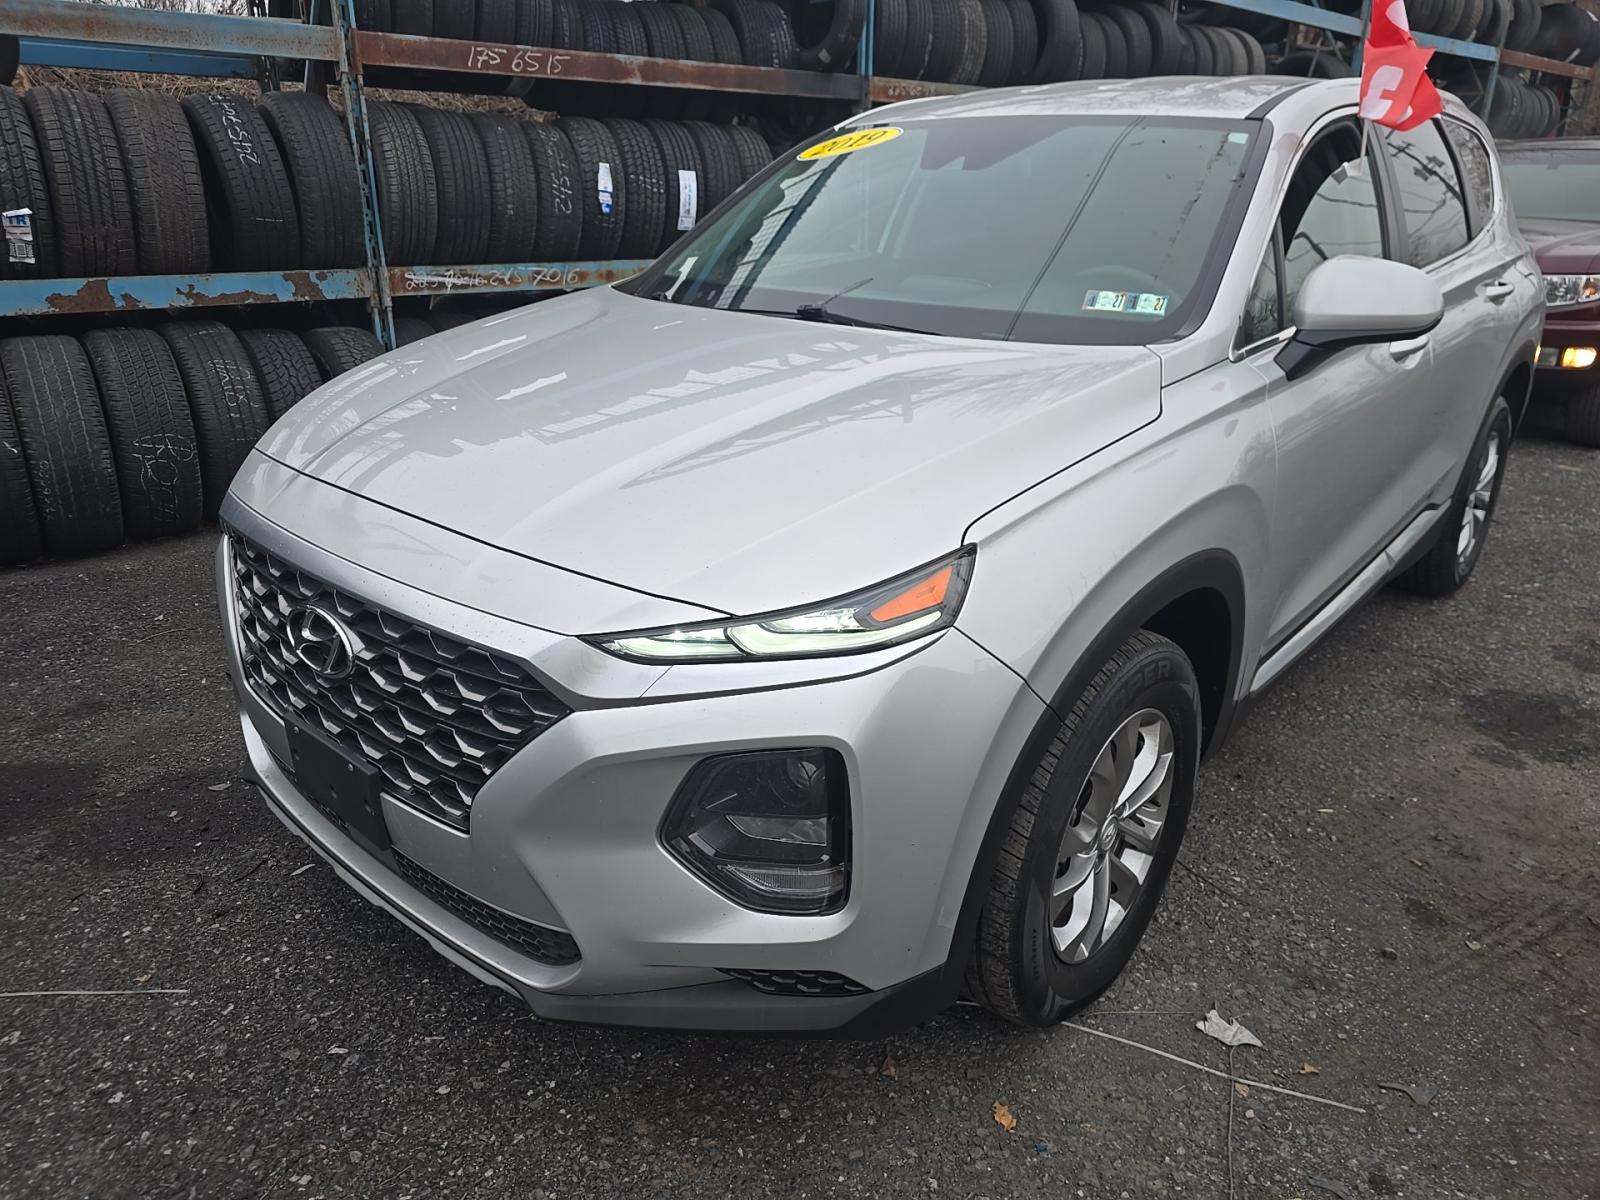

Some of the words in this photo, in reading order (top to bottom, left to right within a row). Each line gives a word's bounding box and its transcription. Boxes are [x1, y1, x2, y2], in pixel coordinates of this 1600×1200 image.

[468, 46, 507, 69] 175
[512, 50, 542, 72] 65
[547, 54, 571, 75] 15
[809, 129, 889, 157] 2019
[1111, 293, 1124, 309] 27
[1153, 296, 1166, 312] 27
